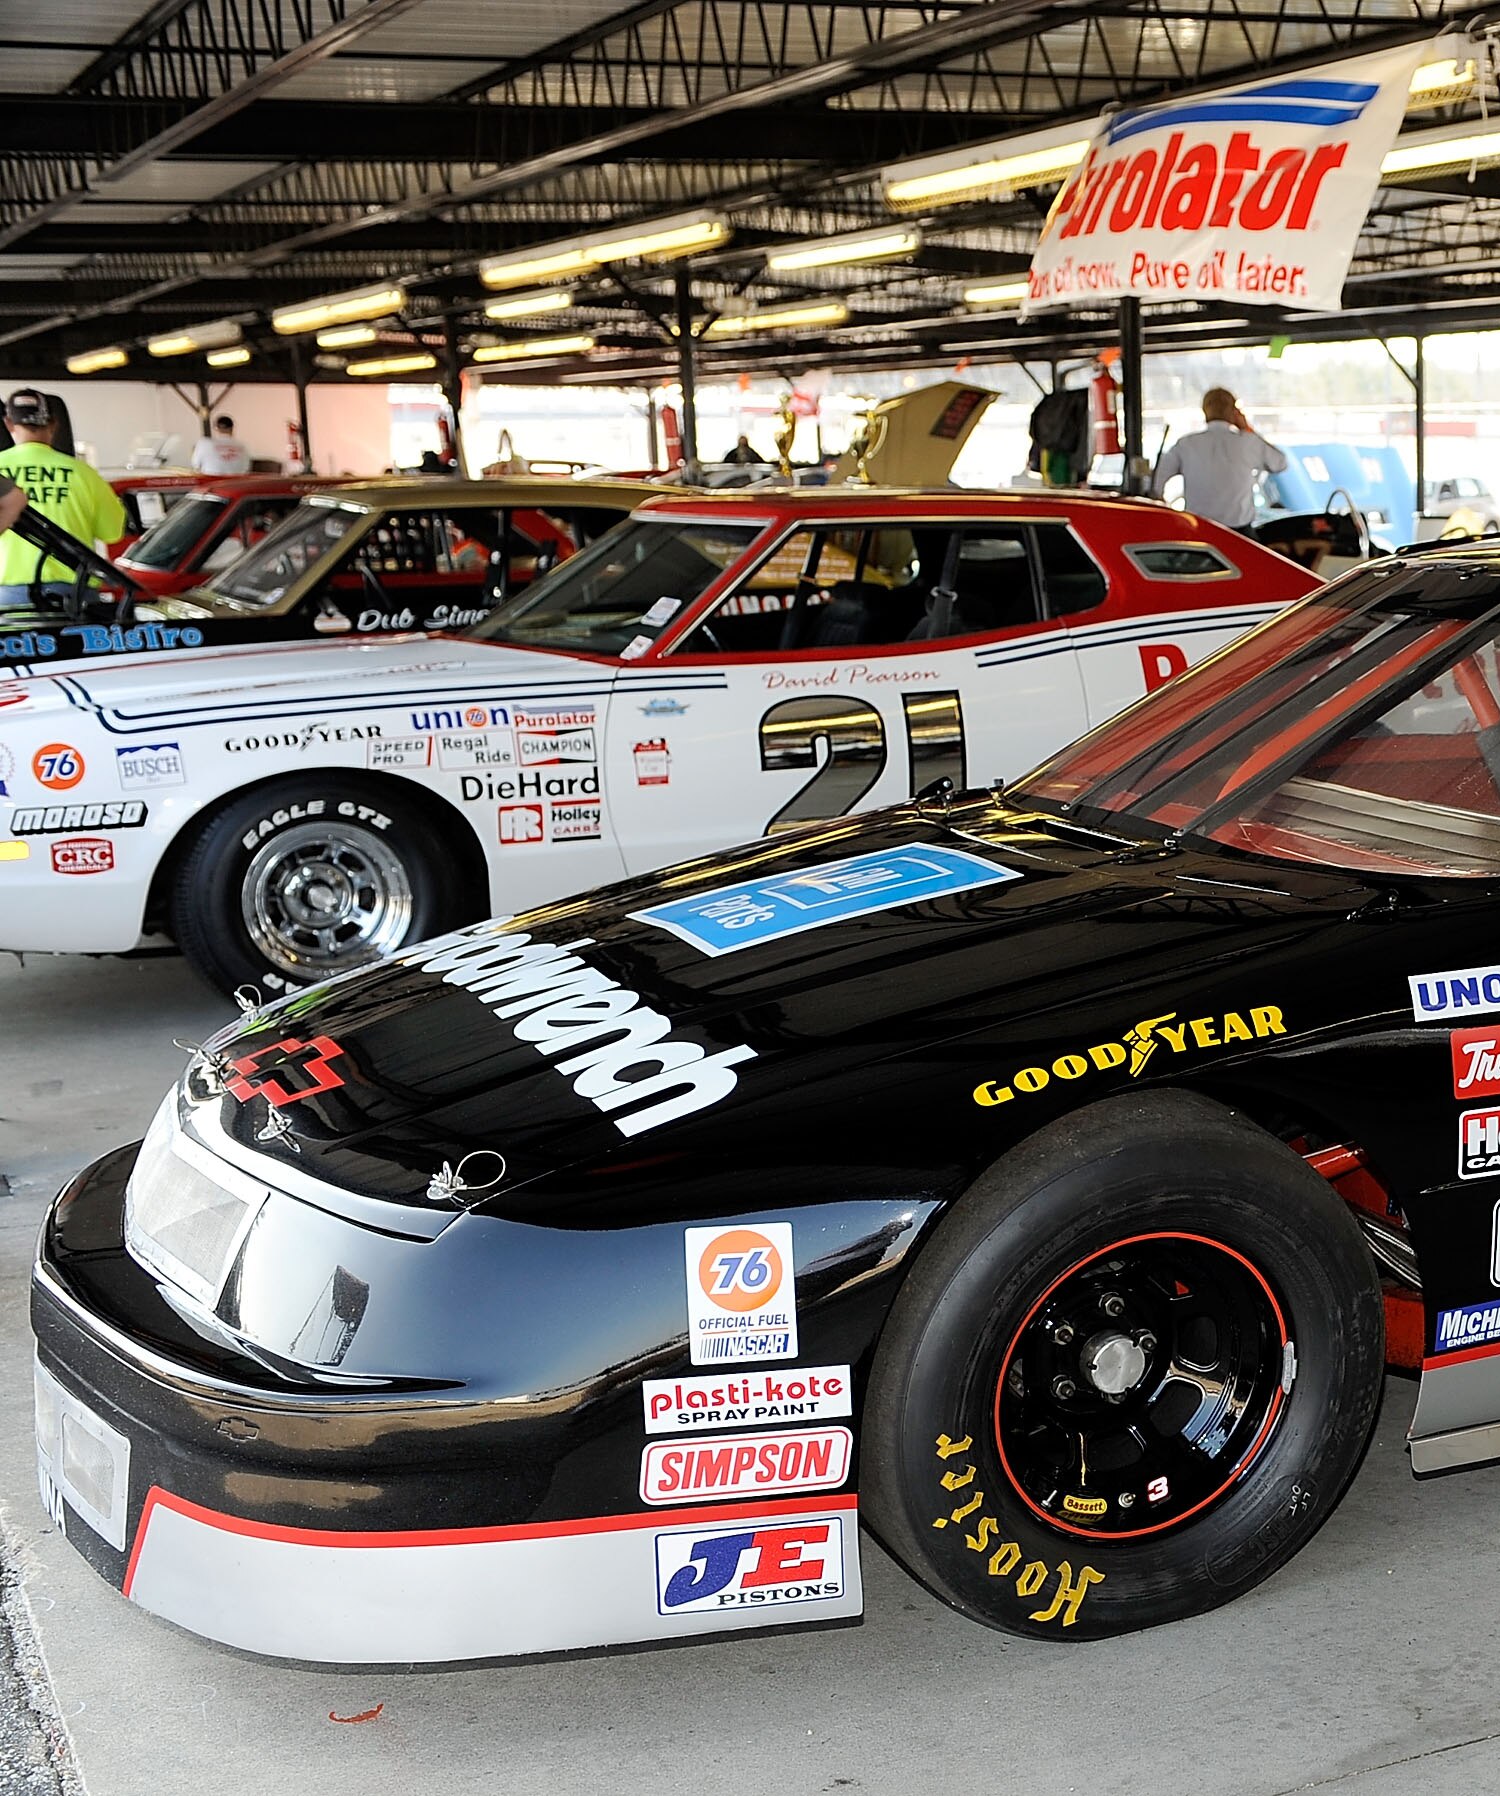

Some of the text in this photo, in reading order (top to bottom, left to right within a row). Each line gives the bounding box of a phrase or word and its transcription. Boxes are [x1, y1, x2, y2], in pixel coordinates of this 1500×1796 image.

[1130, 252, 1190, 291] Pure
[1200, 252, 1226, 289] oil
[1237, 252, 1308, 296] later.
[0, 465, 73, 483] VENT
[26, 486, 69, 504] AFF
[357, 608, 415, 632] Dub
[762, 664, 941, 689] David Pearson
[514, 712, 597, 728] Purolator
[442, 735, 489, 751] Regal
[521, 739, 592, 755] CHAMPION
[41, 752, 77, 780] 76
[123, 756, 179, 777] BUSCH
[475, 751, 511, 764] Ride
[758, 690, 968, 838] 21
[461, 766, 600, 801] DieHard
[11, 801, 148, 835] MOROSO
[242, 800, 327, 850] EAGLE
[552, 809, 600, 825] Holley
[553, 825, 601, 835] CARBS
[55, 848, 111, 866] CRC
[688, 893, 777, 929] Parts
[714, 1249, 770, 1292] 76
[698, 1313, 789, 1330] OFFICIAL FUEL
[727, 1333, 787, 1357] NASCAR
[1447, 1330, 1485, 1348] ENGINE
[650, 1376, 844, 1419] plasti-kote
[677, 1401, 820, 1424] SPRAY PAINT
[658, 1438, 833, 1492] SIMPSON
[1146, 1475, 1169, 1502] 3
[1067, 1498, 1104, 1512] Bassett
[932, 1433, 1106, 1627] Hoosier
[664, 1524, 830, 1607] JE
[717, 1582, 840, 1606] PISTONS
